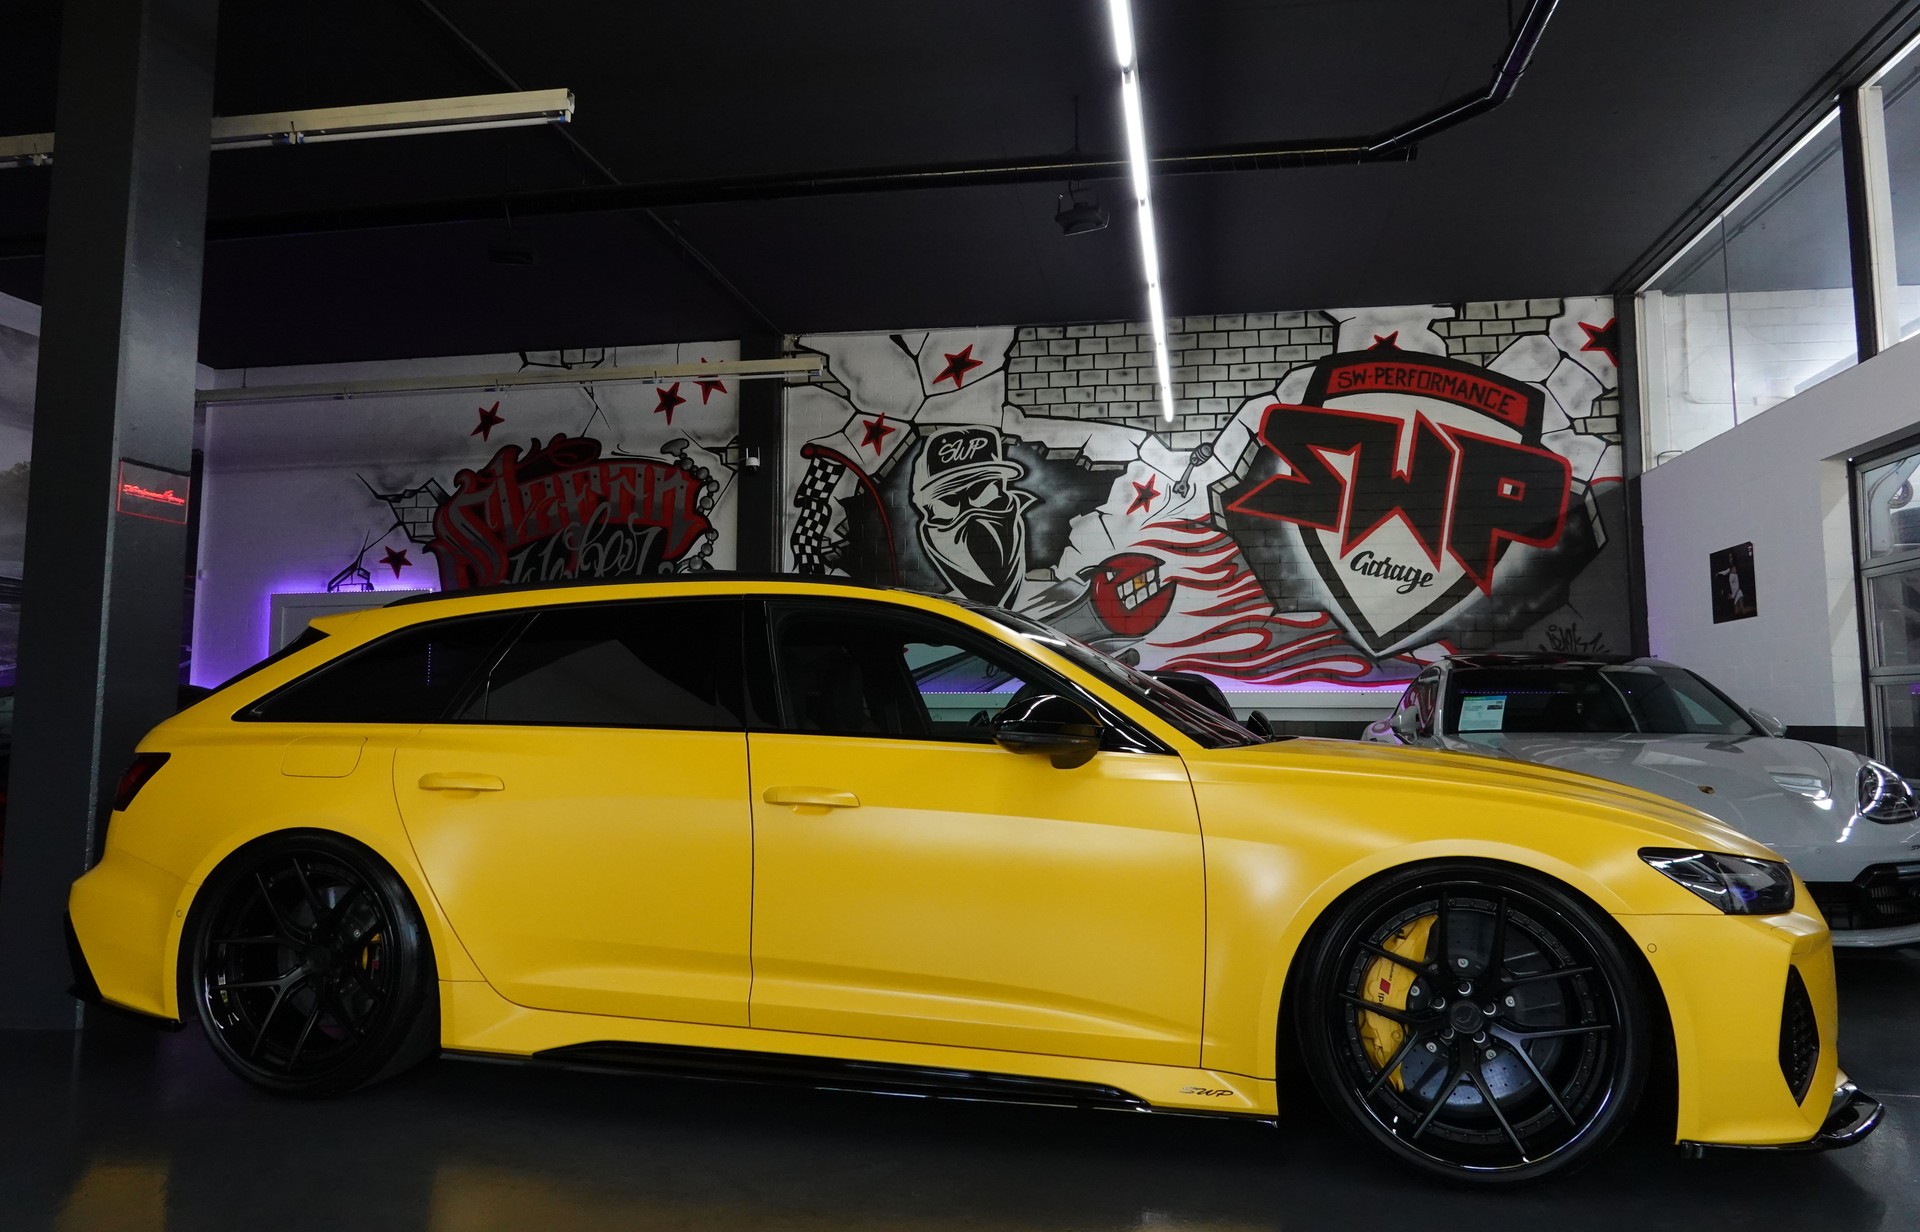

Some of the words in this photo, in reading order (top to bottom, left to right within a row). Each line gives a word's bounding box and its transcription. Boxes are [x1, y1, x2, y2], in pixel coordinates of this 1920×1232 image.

[1337, 366, 1517, 417] SW-PERFORMANCE
[938, 437, 989, 464] SWP
[1226, 403, 1573, 598] SWP
[1349, 550, 1434, 595] Garage
[1179, 1086, 1234, 1098] SWP
